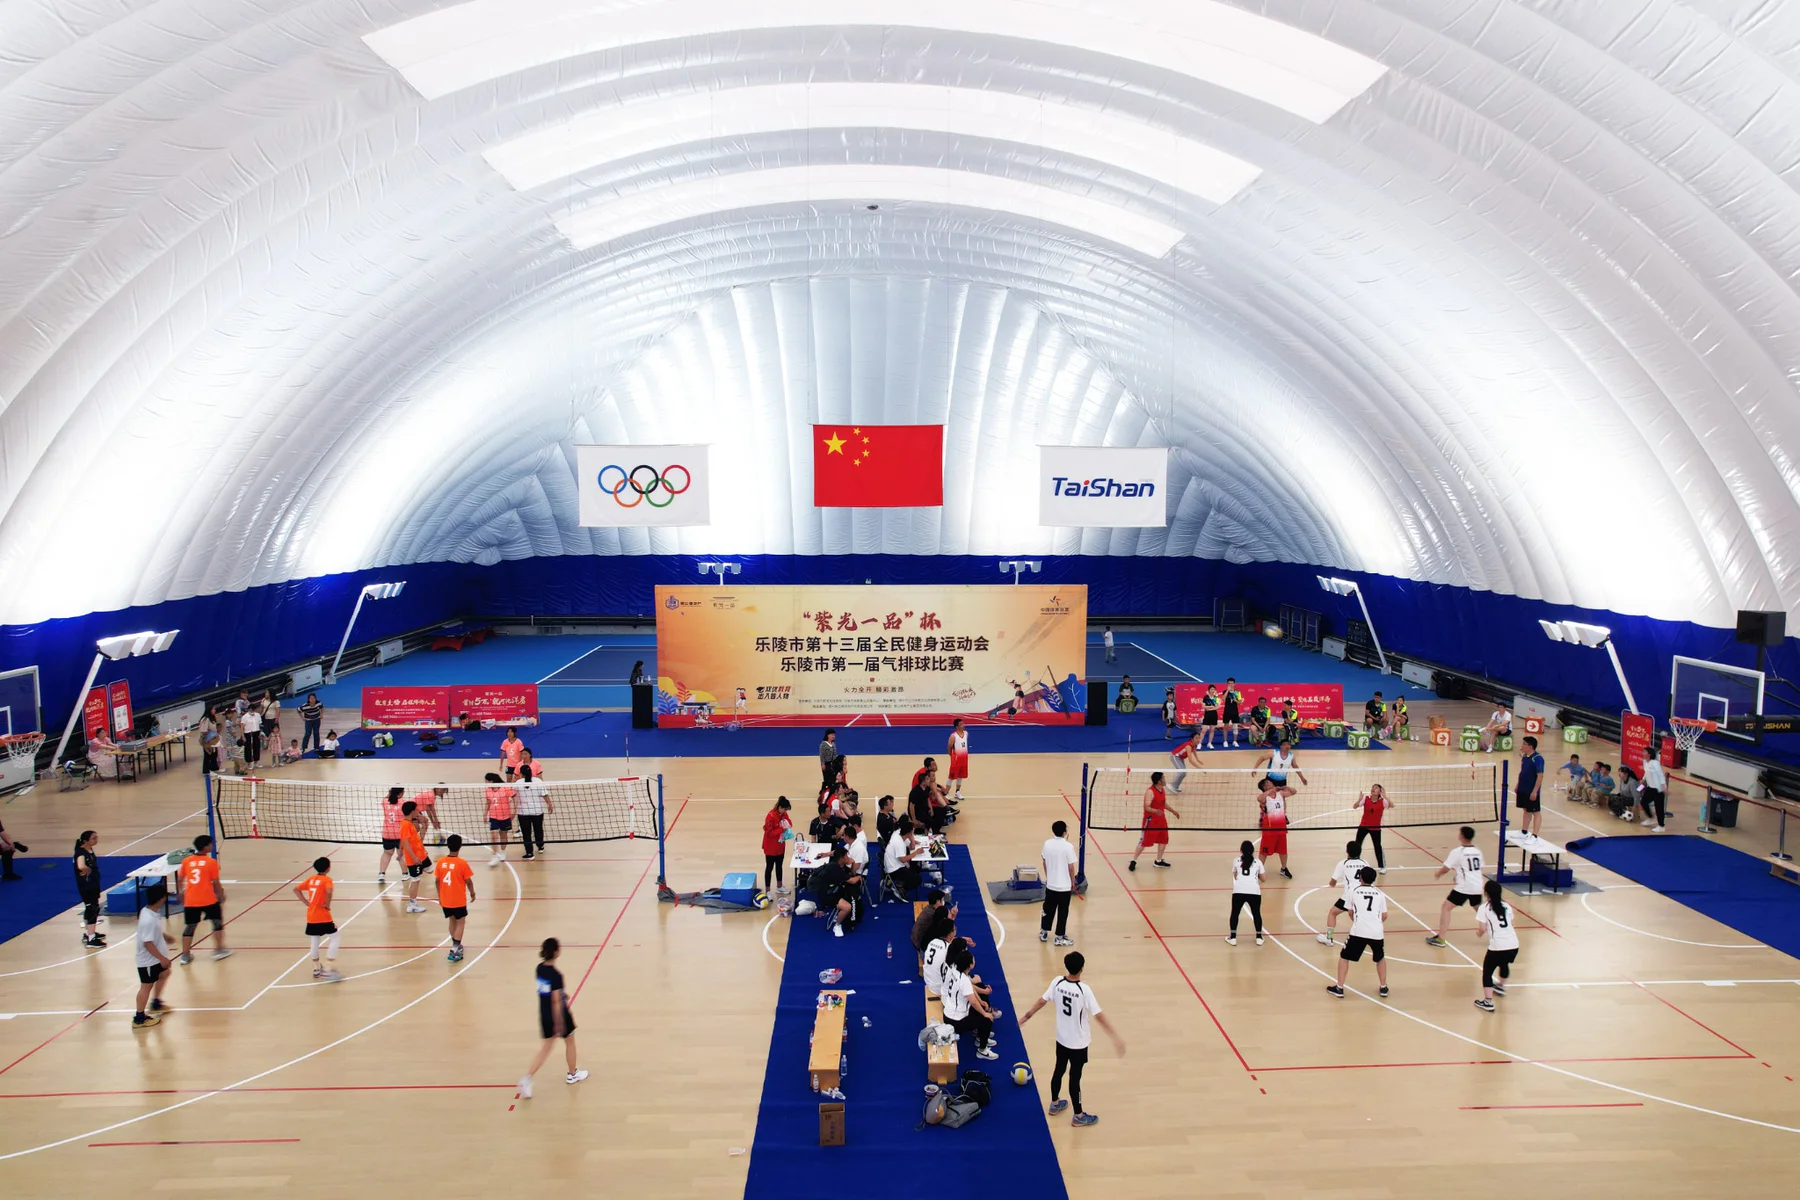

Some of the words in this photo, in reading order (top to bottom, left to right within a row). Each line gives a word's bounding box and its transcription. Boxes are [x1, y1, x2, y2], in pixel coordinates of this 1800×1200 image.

[1052, 477, 1155, 497] TaiShan
[755, 636, 990, 652] 乐陵市第十三届全民健身运动会
[780, 656, 965, 672] 乐陵市第一届气排球比赛
[1467, 857, 1480, 871] 10
[189, 868, 201, 884] 3
[442, 870, 452, 886] 4
[309, 887, 317, 904] 7
[1364, 896, 1374, 911] 7
[1498, 914, 1508, 928] 9
[926, 948, 936, 965] 3
[1061, 995, 1072, 1016] 5
